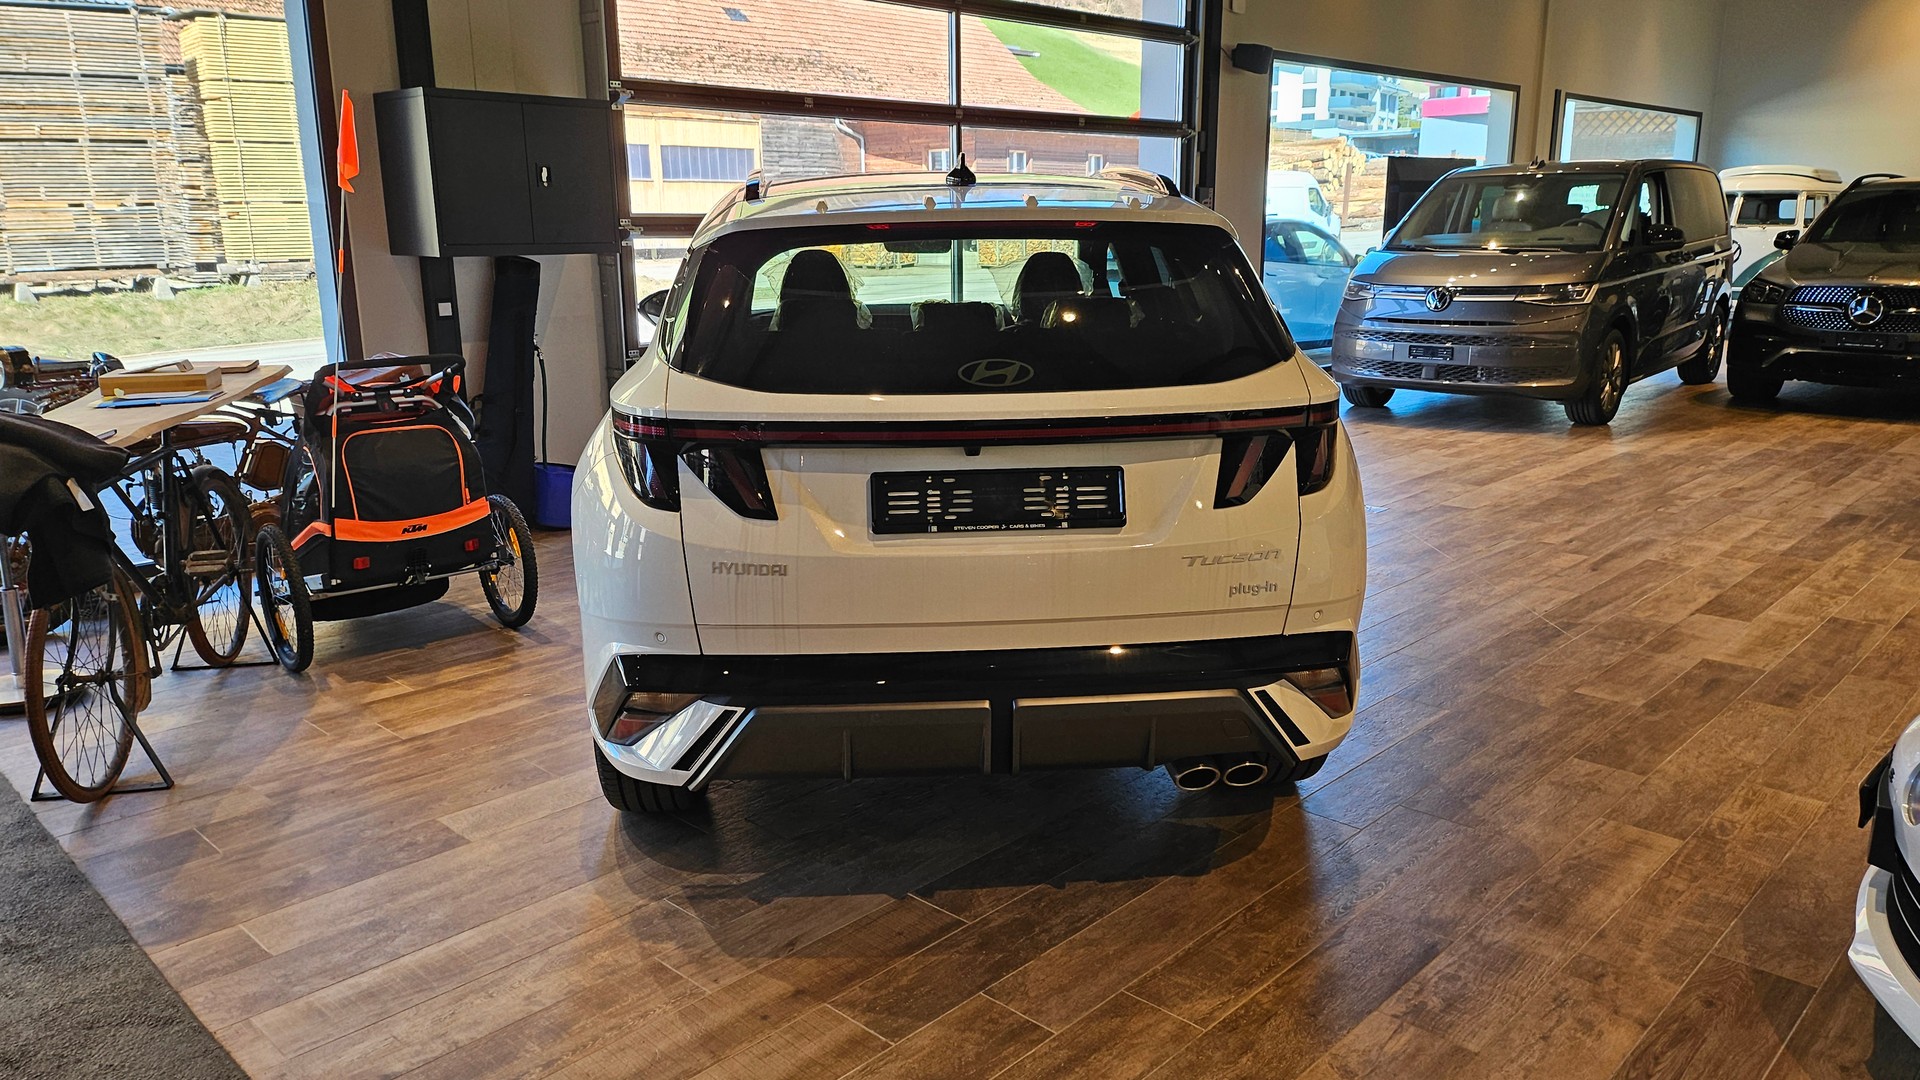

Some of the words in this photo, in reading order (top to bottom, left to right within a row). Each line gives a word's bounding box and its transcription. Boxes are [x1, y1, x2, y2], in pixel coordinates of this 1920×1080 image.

[401, 523, 428, 535] KTM
[711, 561, 788, 577] HYUNDAI
[1228, 580, 1278, 597] plug-in
